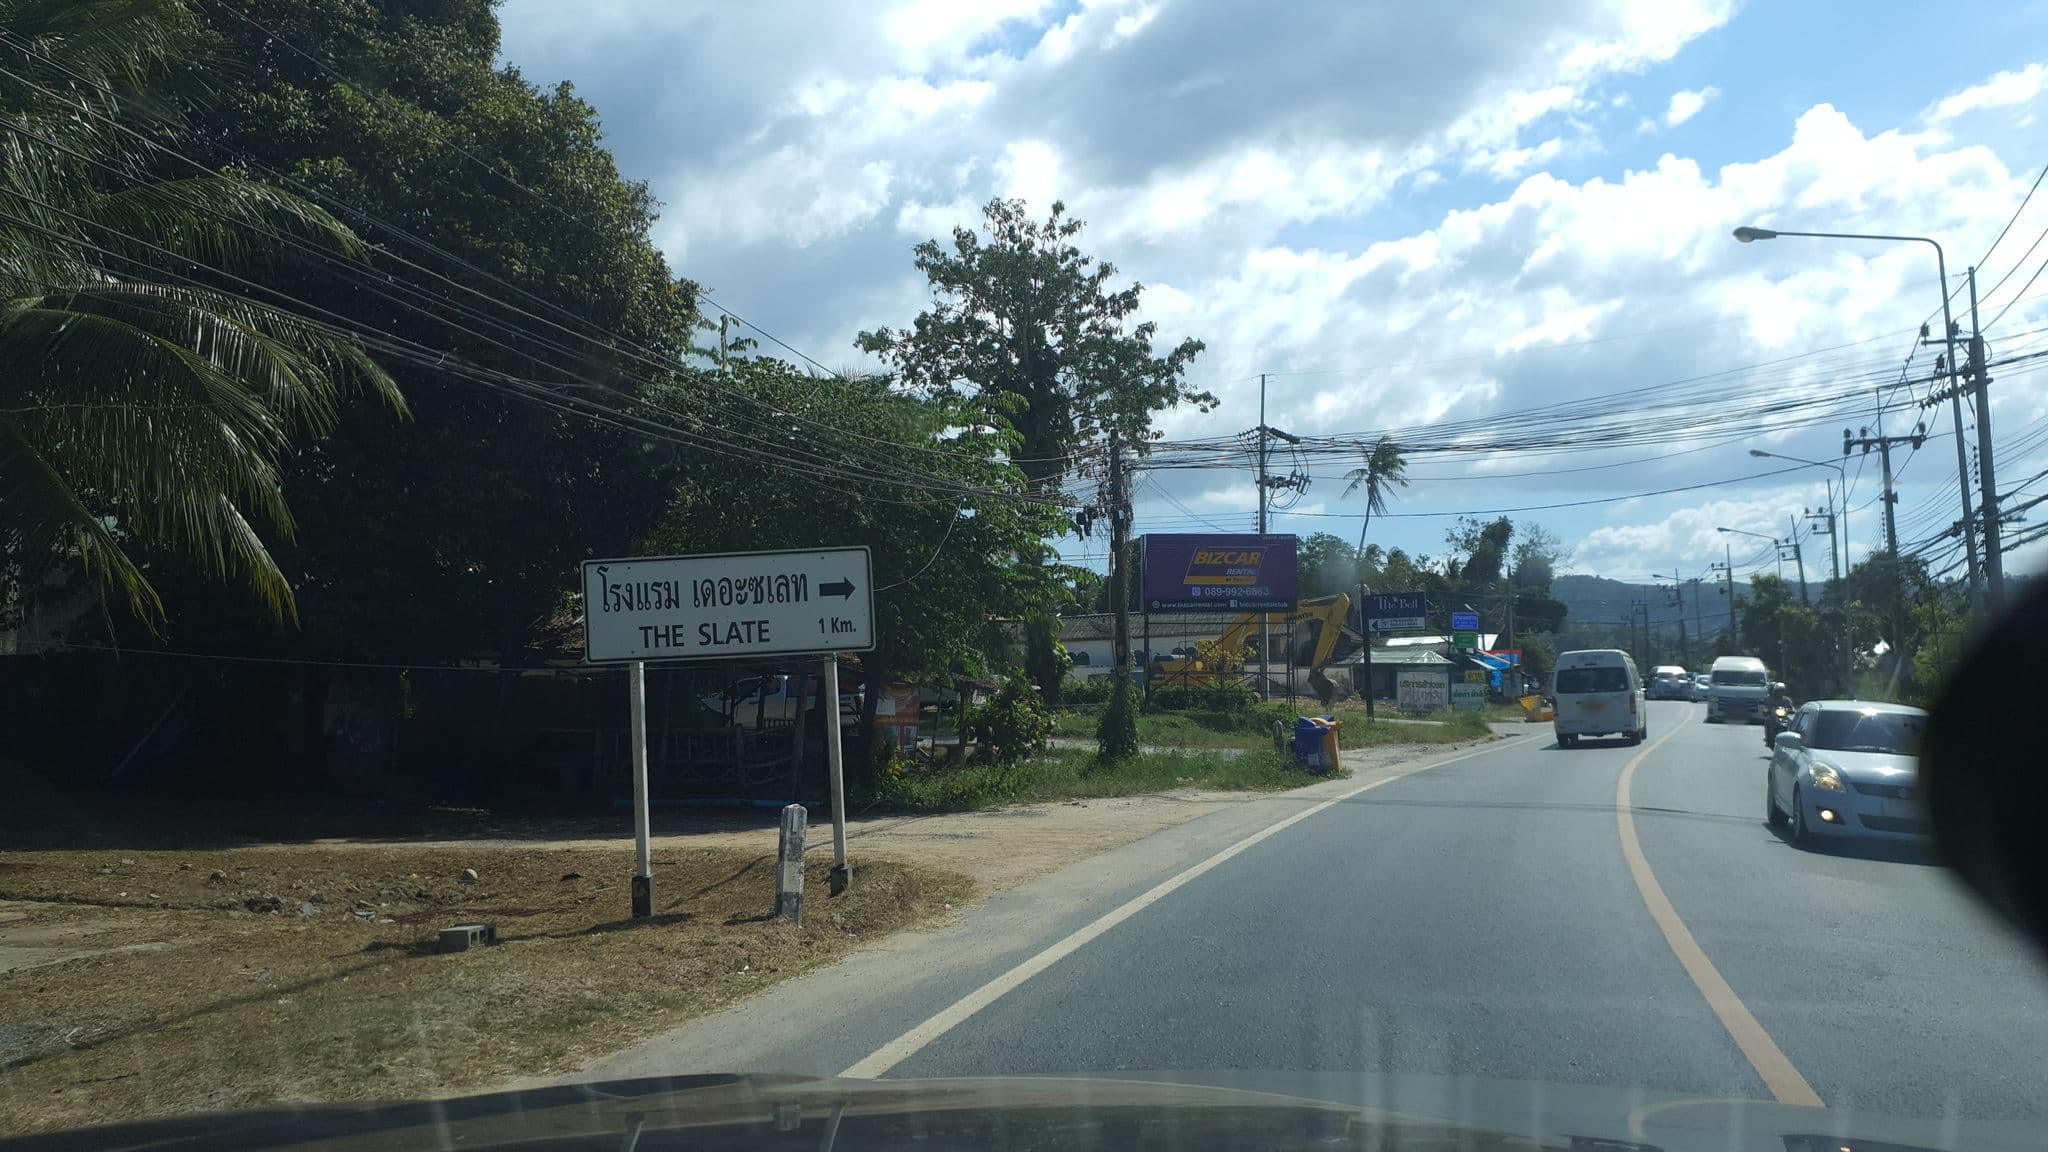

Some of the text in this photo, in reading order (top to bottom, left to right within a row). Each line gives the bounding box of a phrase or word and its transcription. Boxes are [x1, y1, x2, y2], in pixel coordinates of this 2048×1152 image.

[1193, 551, 1262, 566] BIZCAR
[1226, 568, 1257, 576] RENTAL
[596, 565, 680, 613] โรงแรม
[638, 616, 857, 649] THE SLATE 1 Km.
